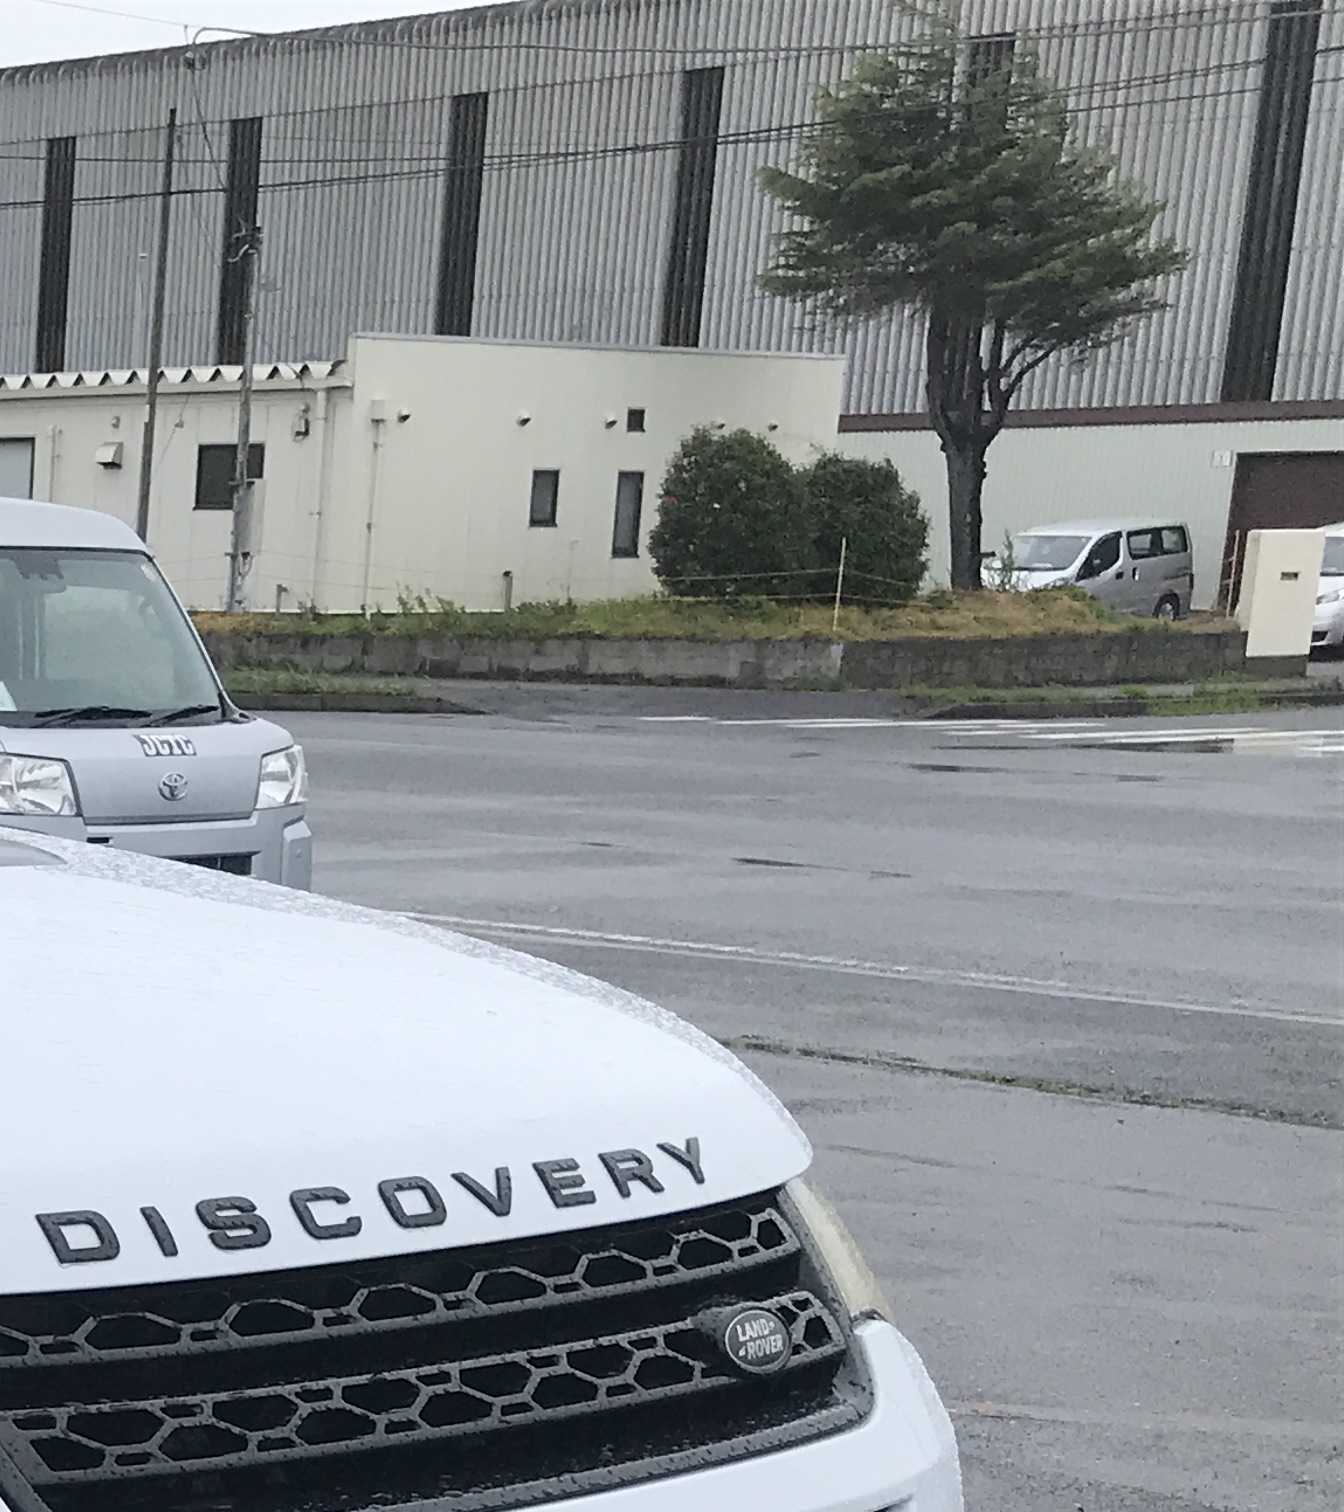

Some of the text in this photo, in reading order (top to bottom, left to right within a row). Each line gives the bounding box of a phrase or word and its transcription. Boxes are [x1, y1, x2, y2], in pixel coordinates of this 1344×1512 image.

[35, 1136, 707, 1266] DISCOVERY
[735, 1317, 771, 1343] LAND
[746, 1333, 784, 1360] ROVER
